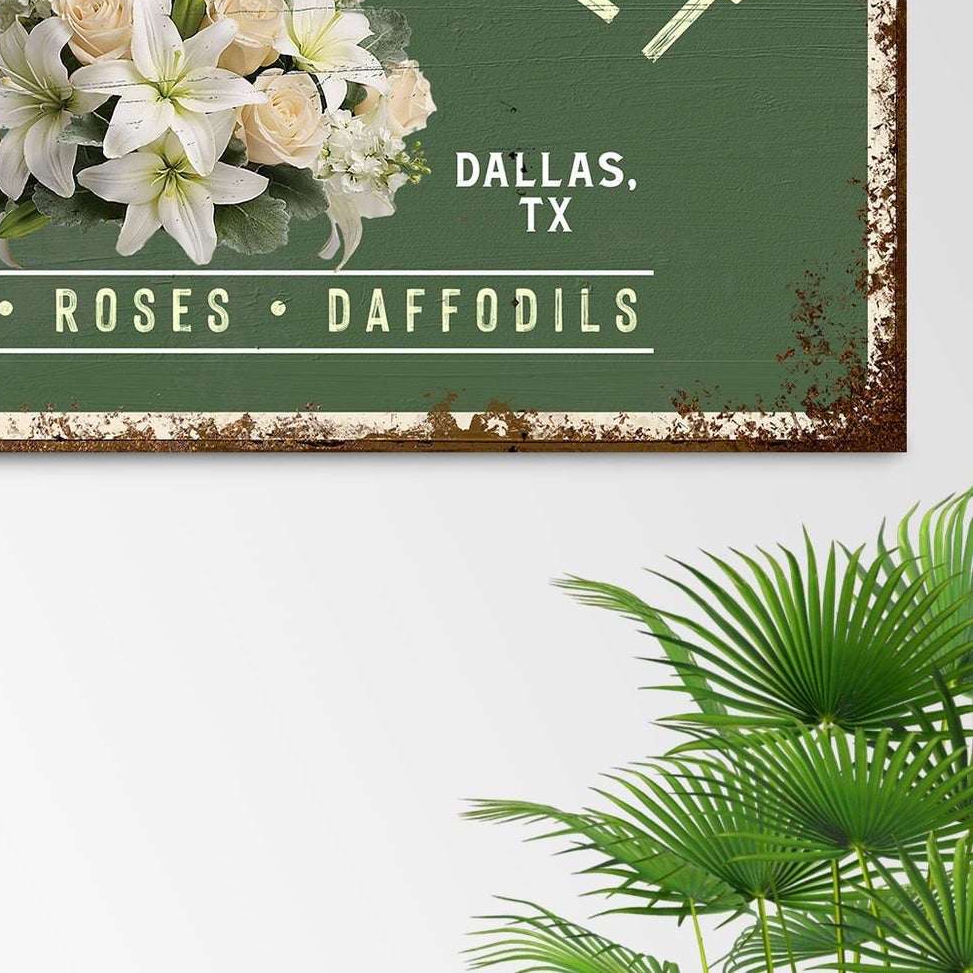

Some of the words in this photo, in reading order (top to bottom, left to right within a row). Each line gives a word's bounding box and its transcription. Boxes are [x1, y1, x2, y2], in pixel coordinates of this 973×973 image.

[456, 152, 637, 191] DALLAS,
[518, 196, 573, 233] TX
[56, 288, 230, 333] ROSES
[329, 288, 637, 333] DAFFODILS
